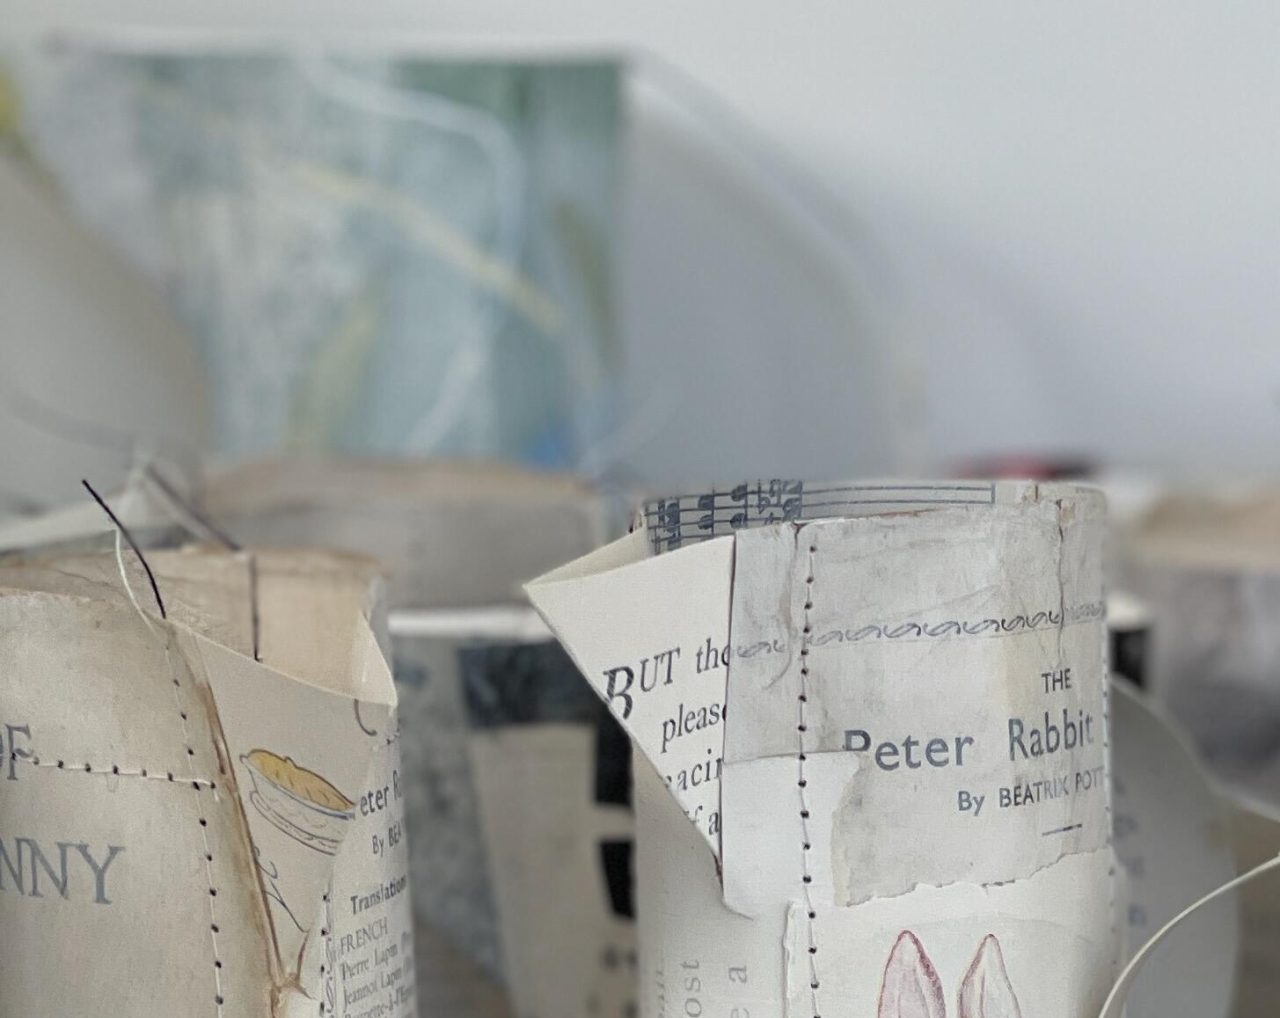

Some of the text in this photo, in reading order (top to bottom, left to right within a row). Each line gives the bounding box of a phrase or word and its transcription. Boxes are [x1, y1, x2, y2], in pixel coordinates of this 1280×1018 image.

[602, 647, 681, 720] BUT
[1041, 668, 1072, 694] THE
[660, 703, 727, 754] pleas
[842, 708, 1095, 771] Peter Rabbit
[0, 724, 34, 780] F
[957, 790, 985, 816] By
[999, 775, 1069, 808] BEATRIX
[340, 916, 388, 956] FRENCH
[728, 964, 748, 985] a
